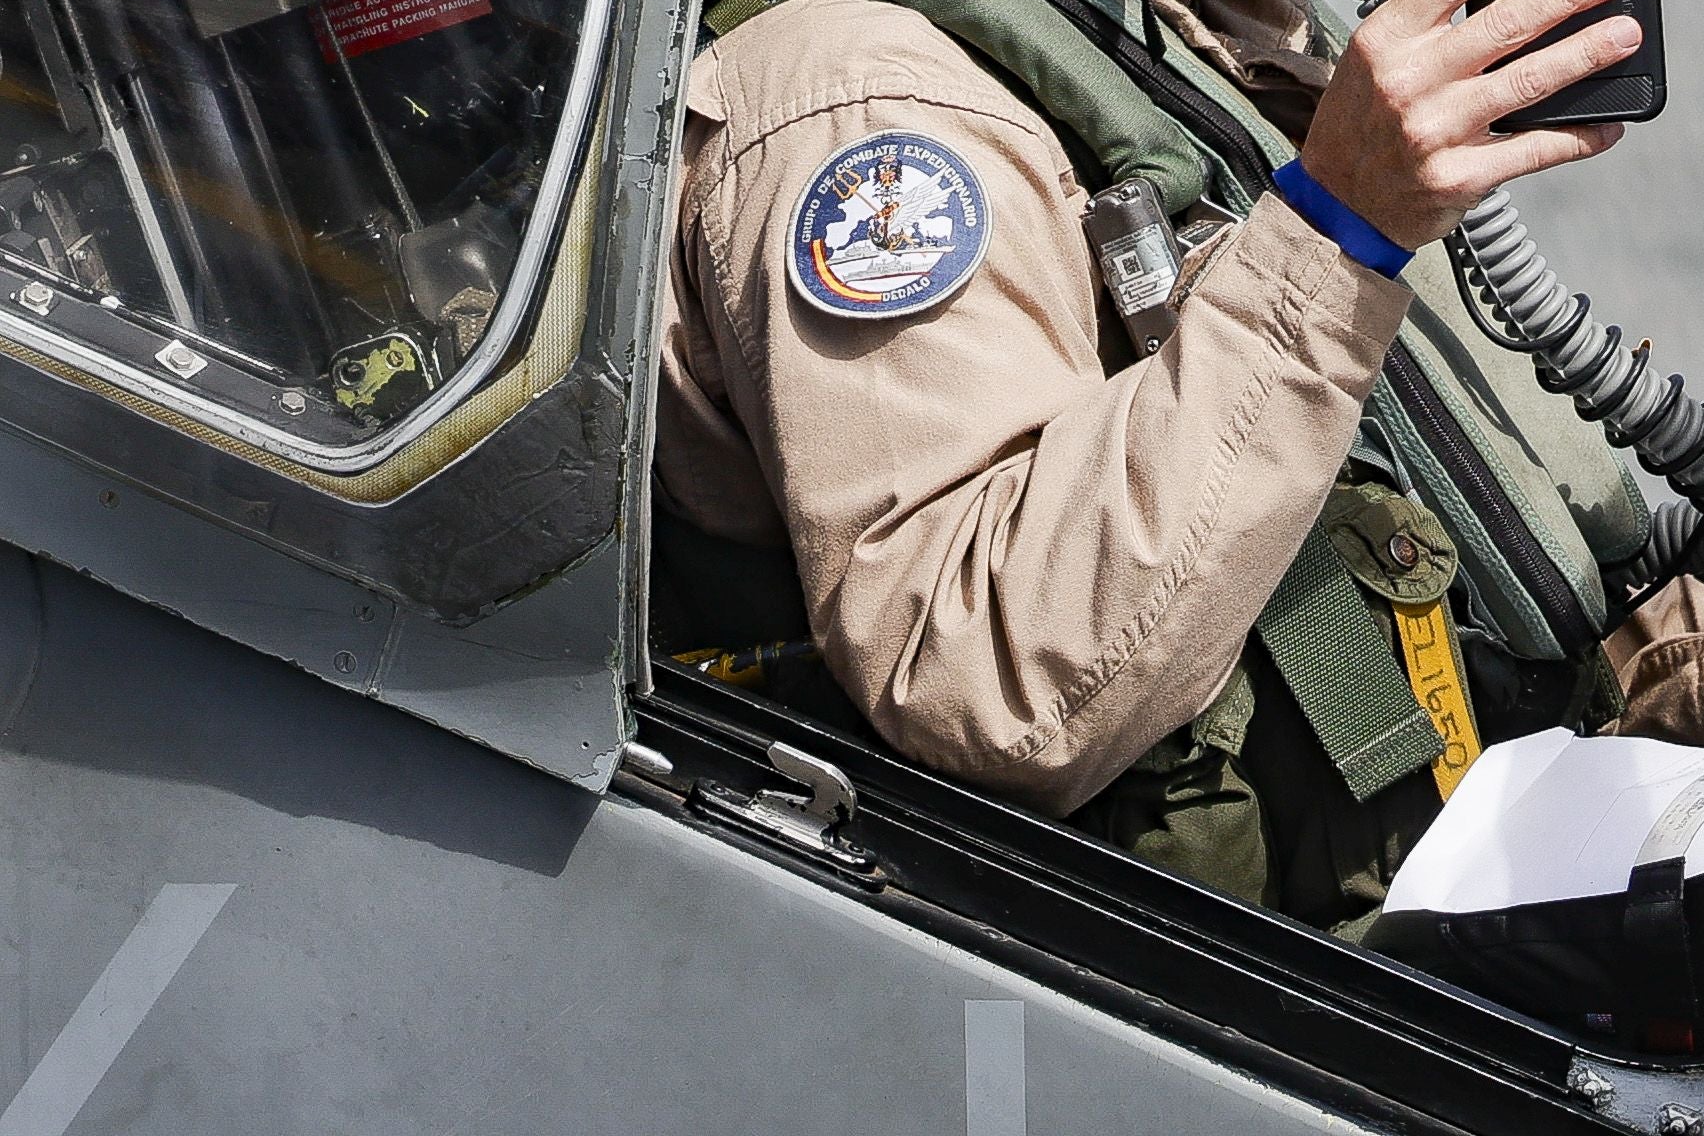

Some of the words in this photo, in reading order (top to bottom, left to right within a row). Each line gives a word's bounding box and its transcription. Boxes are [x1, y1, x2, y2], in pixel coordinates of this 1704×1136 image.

[392, 6, 436, 29] PACKING
[802, 199, 821, 243] GRUPO
[817, 174, 836, 196] DE
[835, 144, 899, 174] COMBATE
[903, 144, 977, 228] EXPEDICIONARIO
[882, 277, 931, 303] DEDALO
